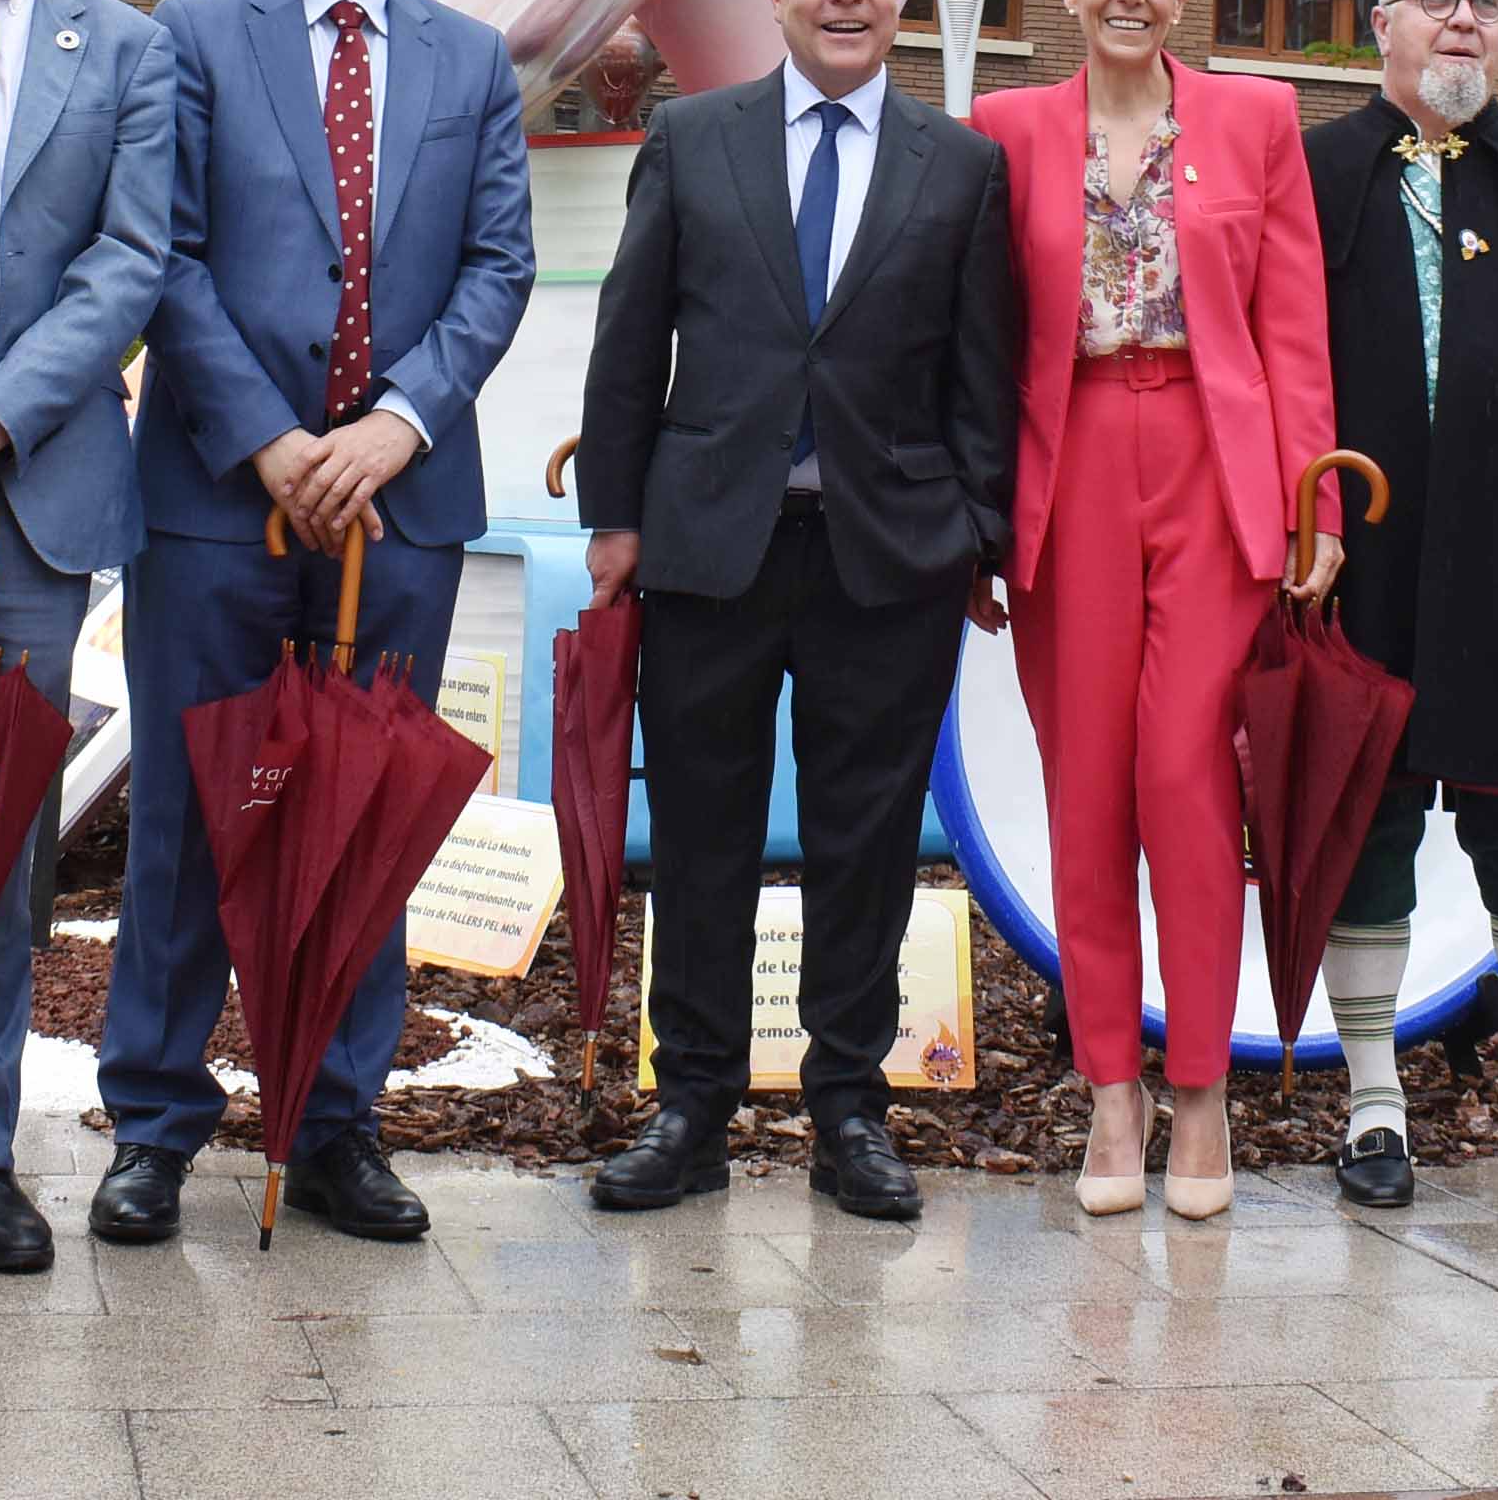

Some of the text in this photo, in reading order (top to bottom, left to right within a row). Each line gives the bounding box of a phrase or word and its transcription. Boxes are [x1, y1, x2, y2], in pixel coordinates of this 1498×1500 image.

[458, 680, 490, 698] personaje
[477, 838, 488, 849] de
[499, 842, 532, 858] Mancha
[458, 885, 517, 909] impresionante
[517, 900, 533, 913] que
[447, 910, 484, 928] FALLERS
[483, 918, 499, 932] PEL
[759, 929, 786, 942] ote
[757, 960, 777, 974] de
[769, 994, 790, 1006] en
[751, 1027, 803, 1039] remos
